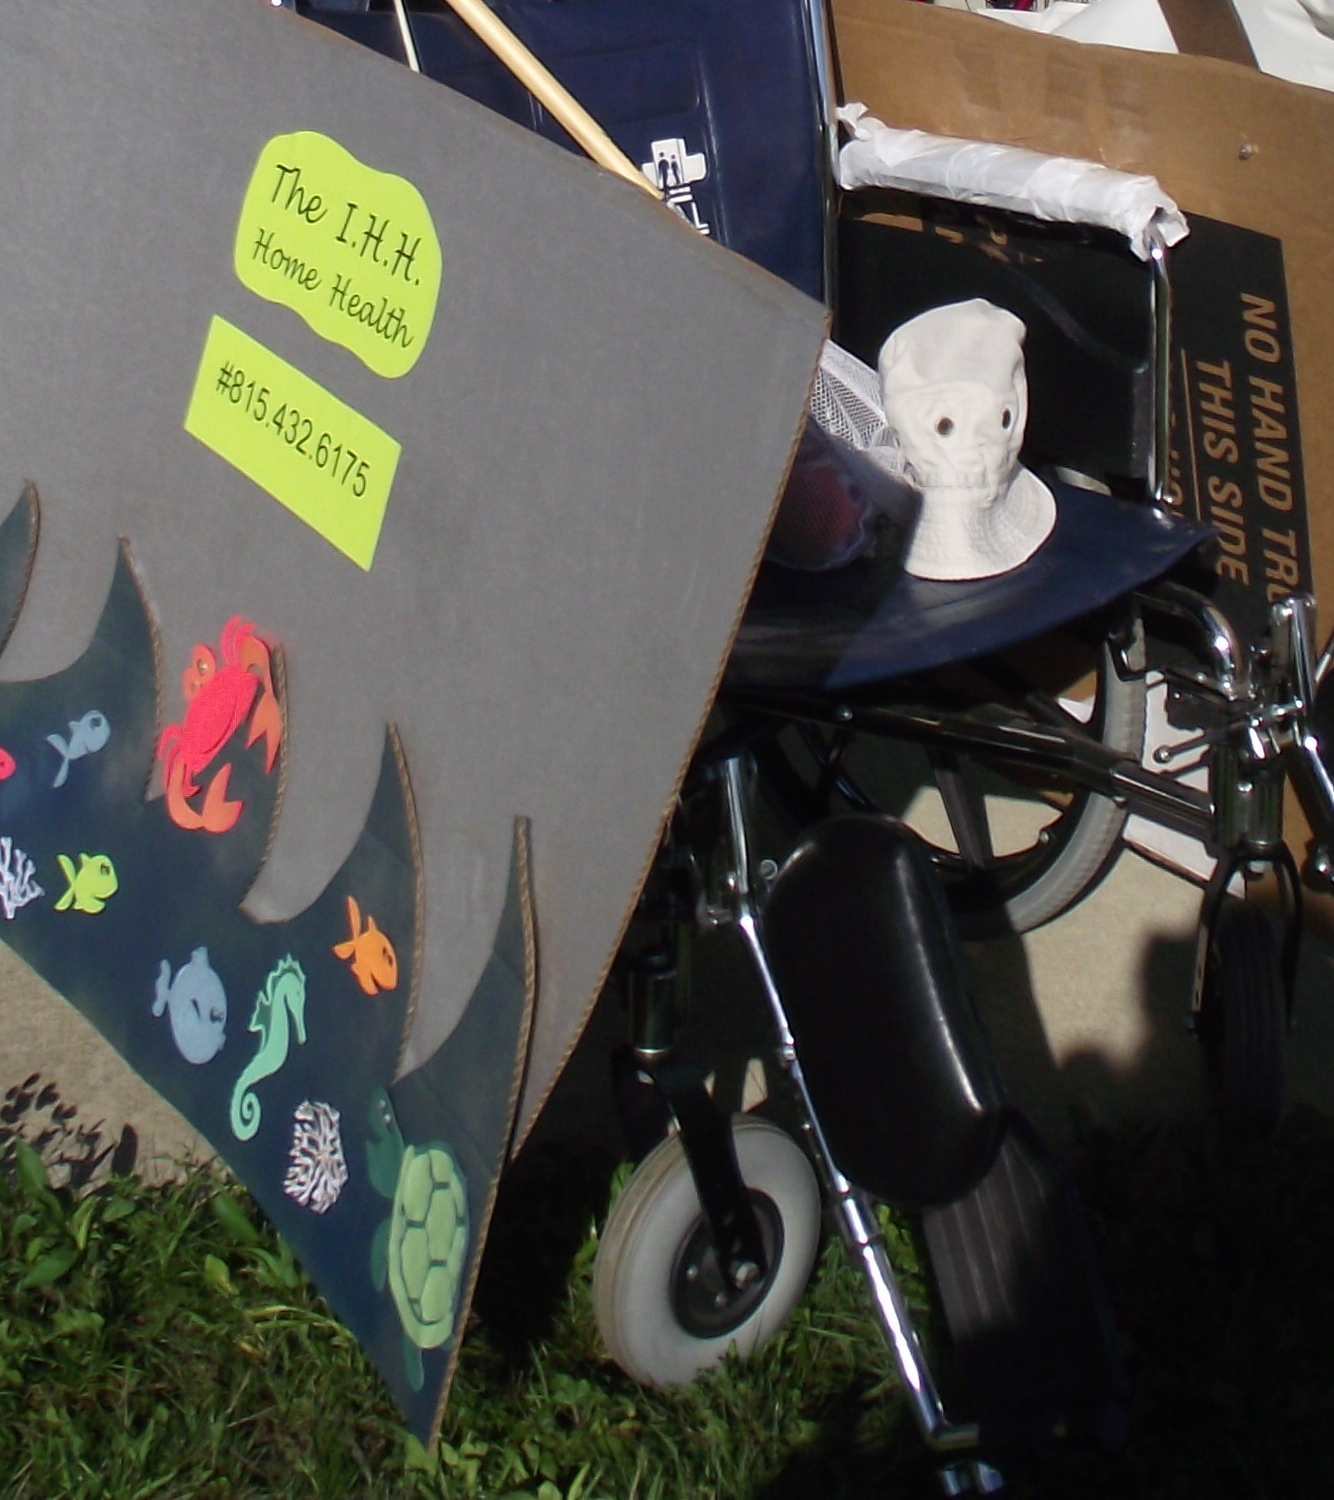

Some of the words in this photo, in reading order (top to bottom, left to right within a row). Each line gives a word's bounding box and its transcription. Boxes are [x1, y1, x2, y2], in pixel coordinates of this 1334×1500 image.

[270, 163, 327, 224] The
[252, 228, 322, 291] Home
[328, 273, 414, 349] Health
[1240, 291, 1281, 364] NO
[215, 361, 370, 499] #815.432.6175
[1195, 360, 1240, 465] THIS
[1247, 375, 1294, 512] HAND
[1207, 474, 1252, 587] SIDE
